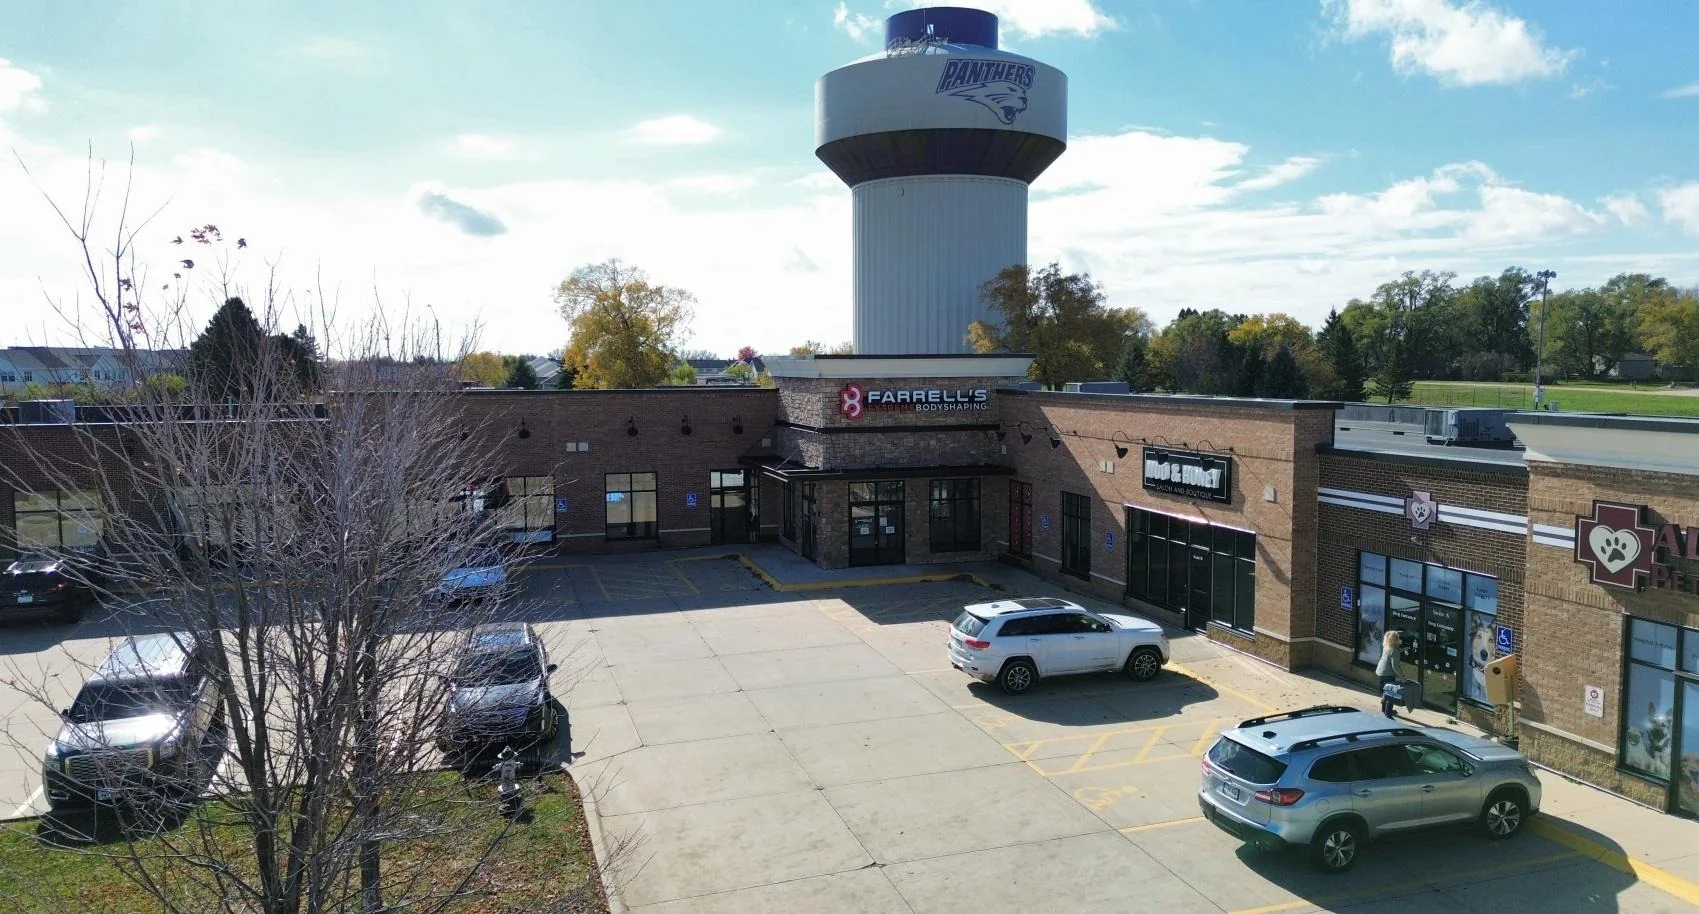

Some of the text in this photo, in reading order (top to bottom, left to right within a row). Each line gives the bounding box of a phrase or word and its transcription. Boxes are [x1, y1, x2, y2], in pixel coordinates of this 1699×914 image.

[936, 59, 1036, 94] PANTHERS
[868, 390, 987, 403] FARRELL'S
[916, 402, 987, 412] BODYSHAPING
[1171, 463, 1181, 483] &
[1182, 465, 1222, 488] HONEY
[1156, 485, 1212, 499] SALON AND BOUTIQUE
